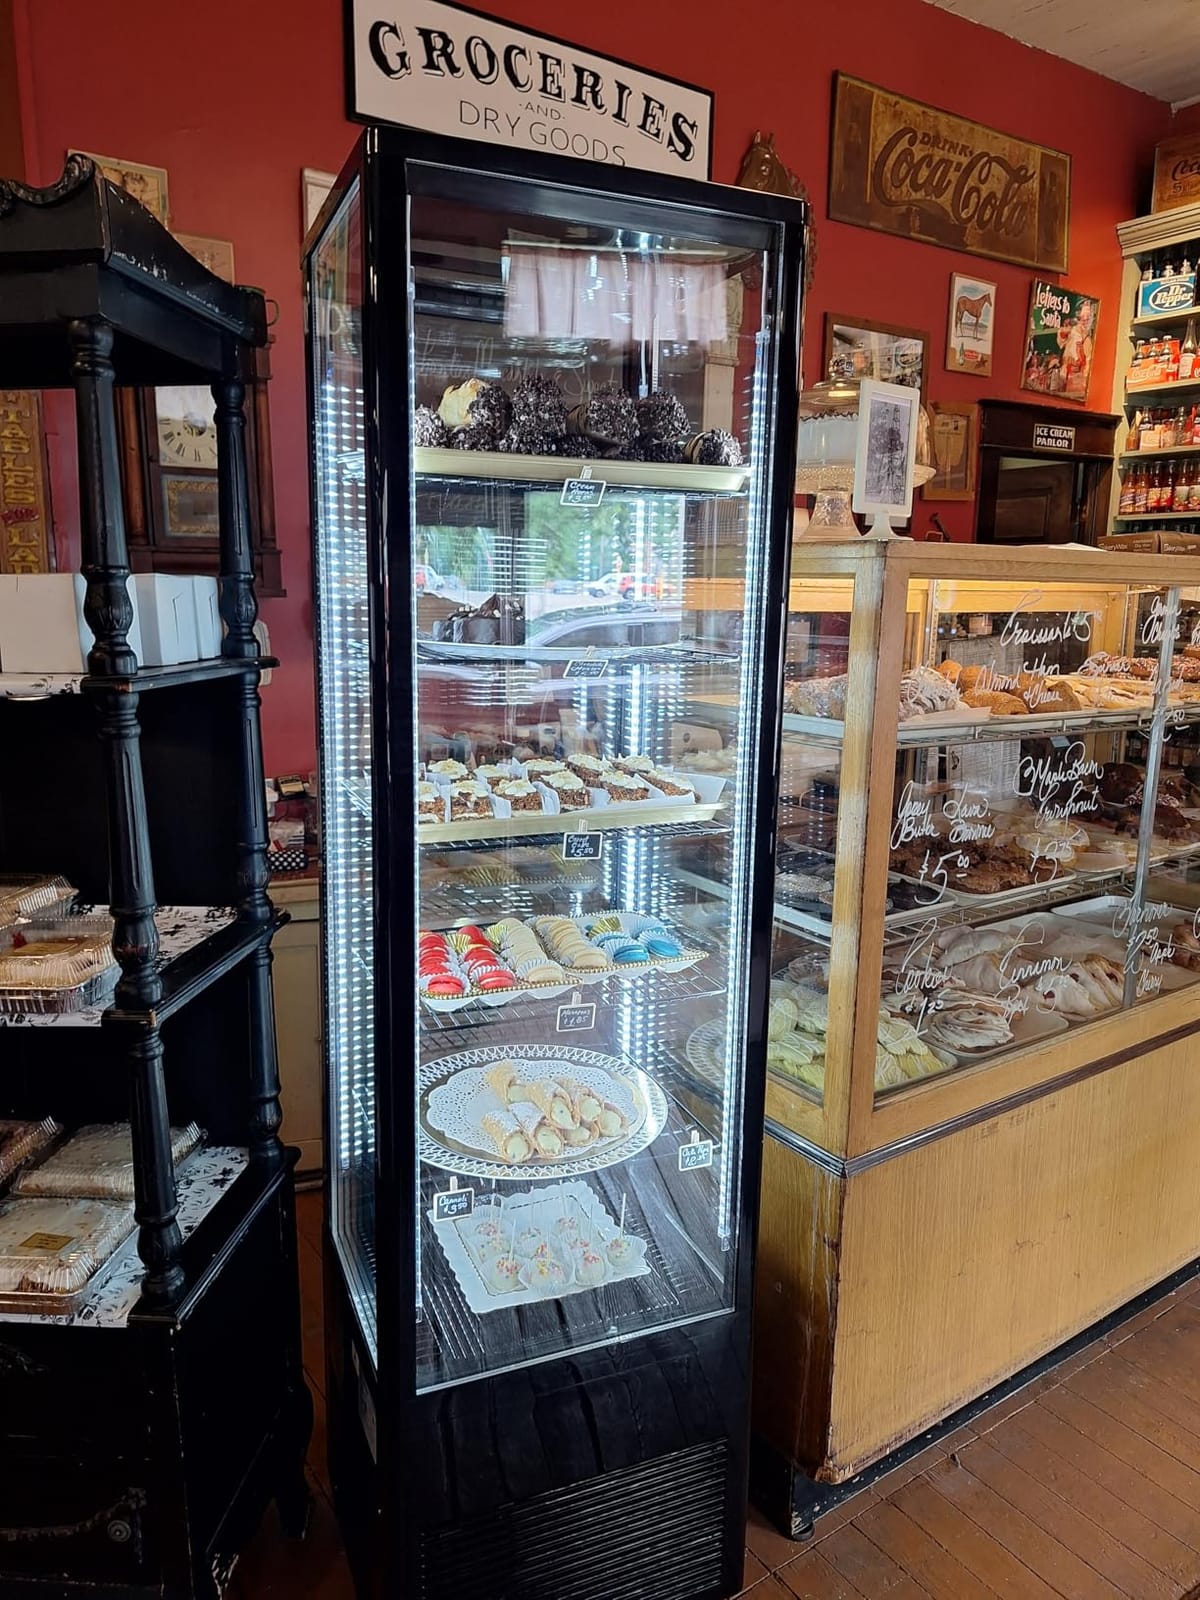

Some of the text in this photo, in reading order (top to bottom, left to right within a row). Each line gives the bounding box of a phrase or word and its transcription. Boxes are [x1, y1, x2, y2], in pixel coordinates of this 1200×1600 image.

[368, 20, 698, 162] GROCERIES
[459, 100, 626, 166] DRY GOODS
[919, 131, 970, 157] DRINK
[1036, 282, 1070, 314] Letters to
[1155, 291, 1194, 308] Pepper
[1169, 284, 1186, 297] Dr
[1040, 308, 1061, 329] Santa
[1036, 426, 1073, 439] ICE CREAM
[1036, 436, 1069, 448] PARLOR
[973, 659, 1022, 697] Almond
[999, 921, 1073, 990] Cinnamon
